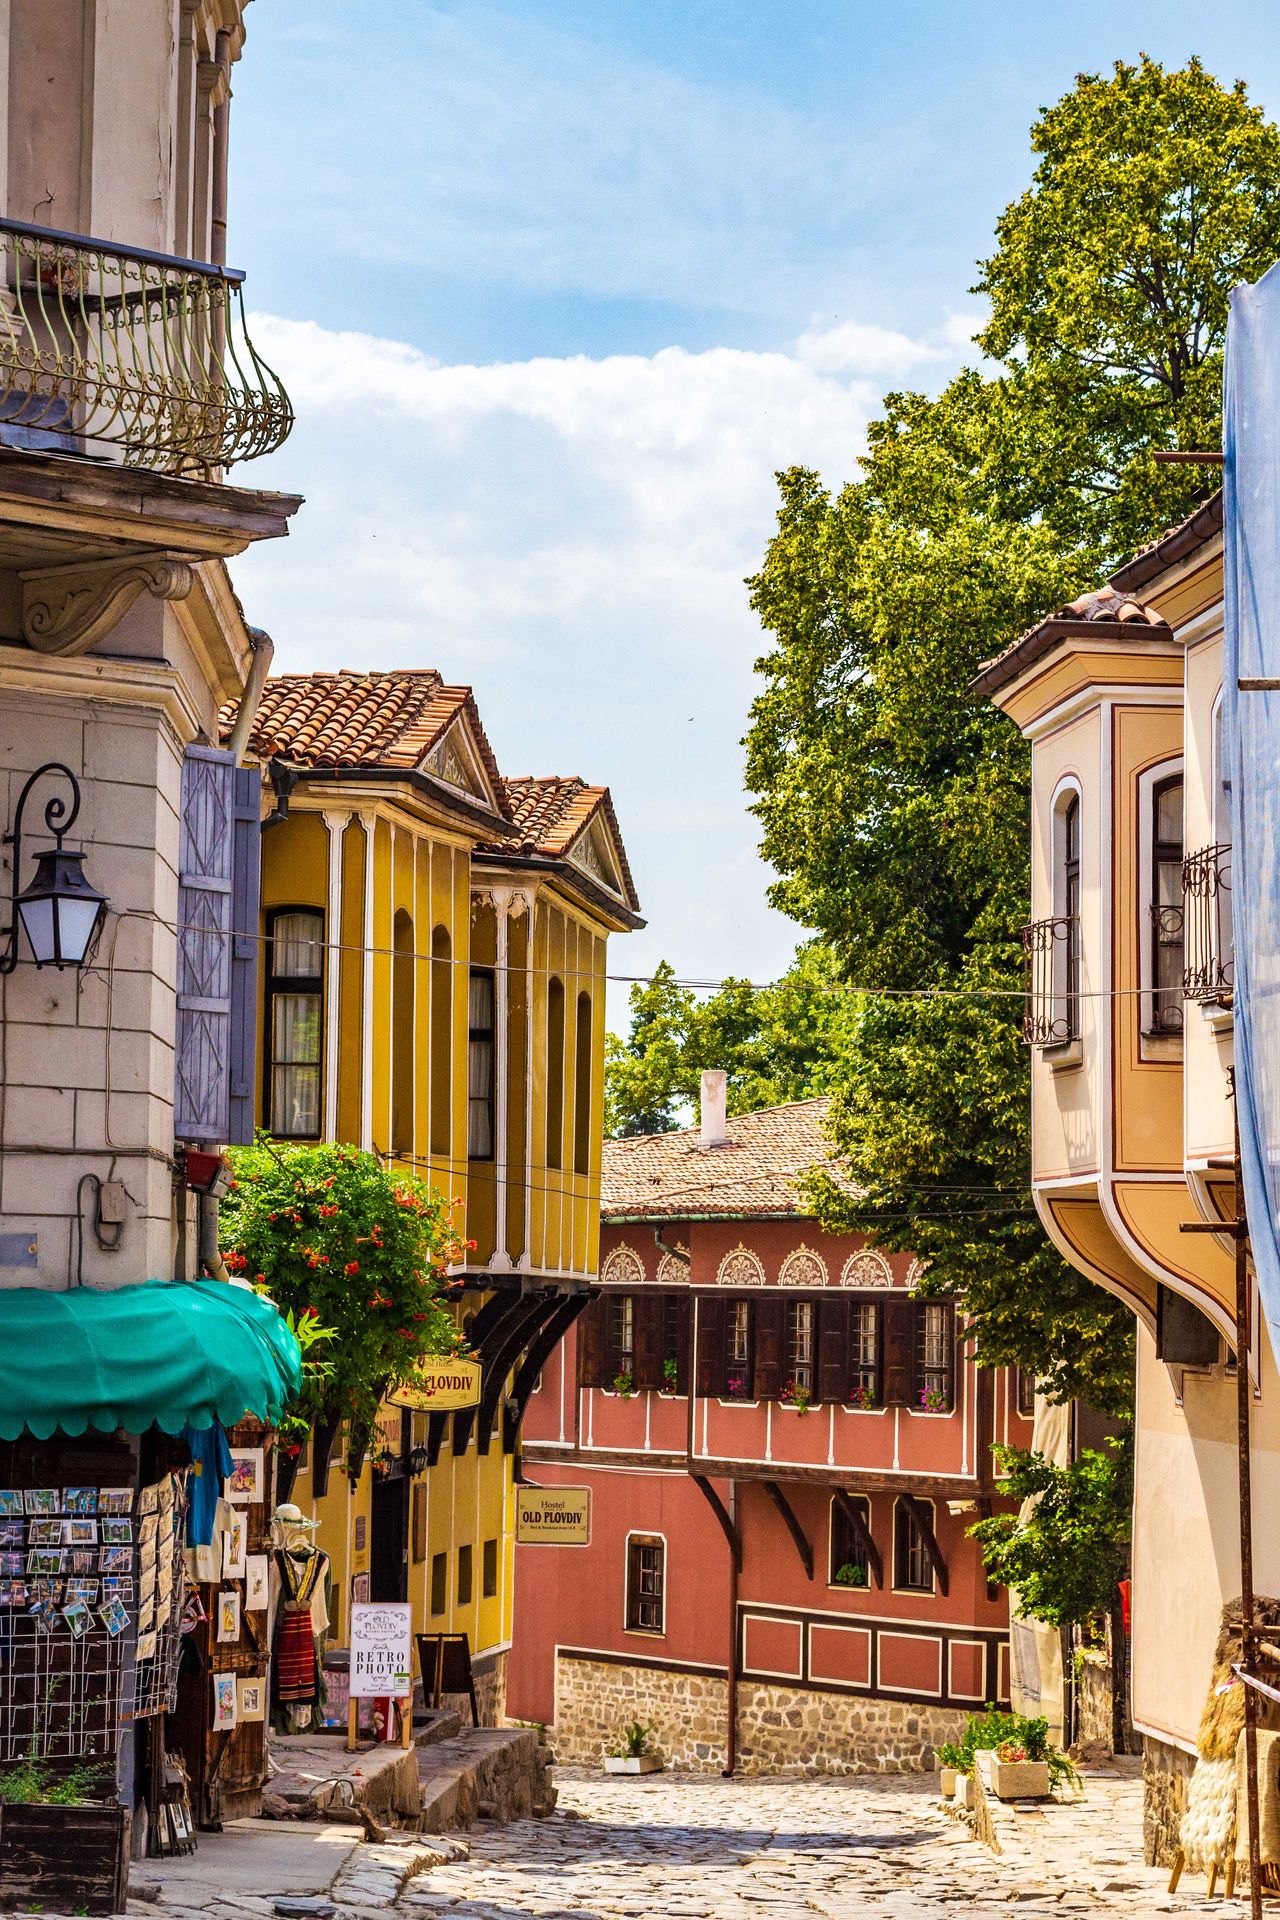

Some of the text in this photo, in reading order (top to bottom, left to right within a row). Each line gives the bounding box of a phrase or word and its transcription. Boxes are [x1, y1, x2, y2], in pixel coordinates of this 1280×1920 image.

[522, 1511, 582, 1523] OLD PLOVDIV
[364, 1622, 398, 1630] PLOVDIV
[356, 1651, 405, 1663] RETRO
[356, 1663, 404, 1675] PHOTO
